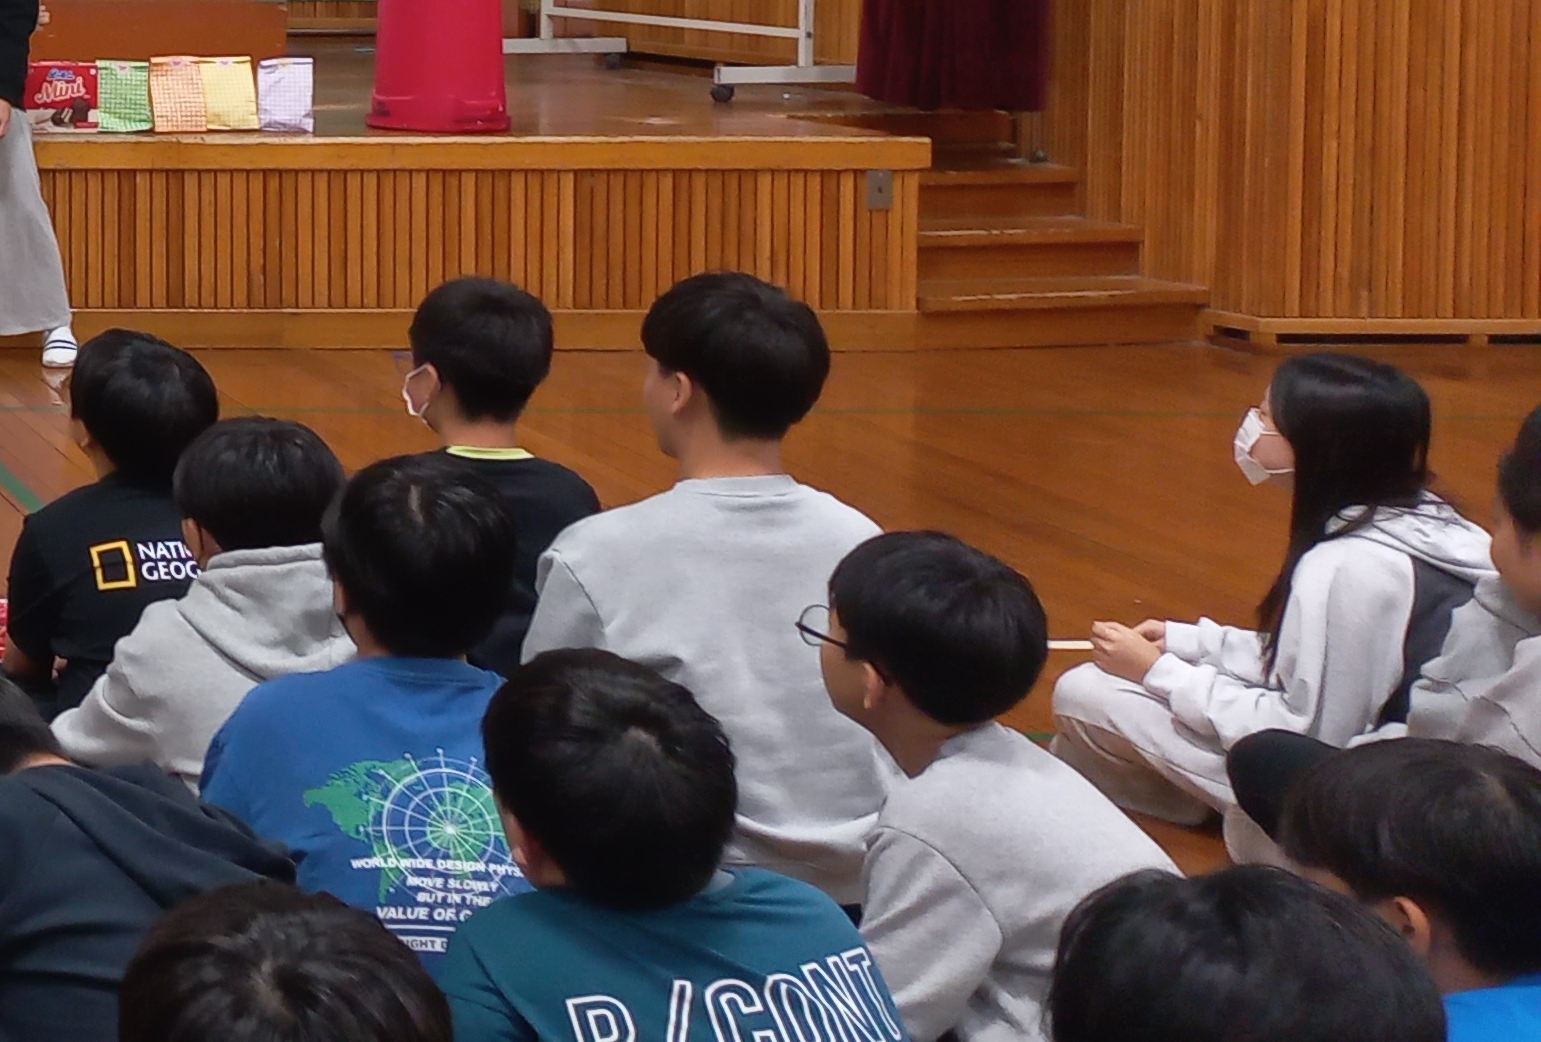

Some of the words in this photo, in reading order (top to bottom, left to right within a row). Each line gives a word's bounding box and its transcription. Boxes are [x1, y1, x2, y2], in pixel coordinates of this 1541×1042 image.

[34, 76, 86, 103] Mini
[350, 857, 398, 870] WORLD
[437, 859, 485, 872] DESIGN
[488, 863, 524, 878] PHYS
[406, 876, 444, 888] MOVE
[417, 892, 446, 903] BUT
[376, 906, 429, 920] VALUE
